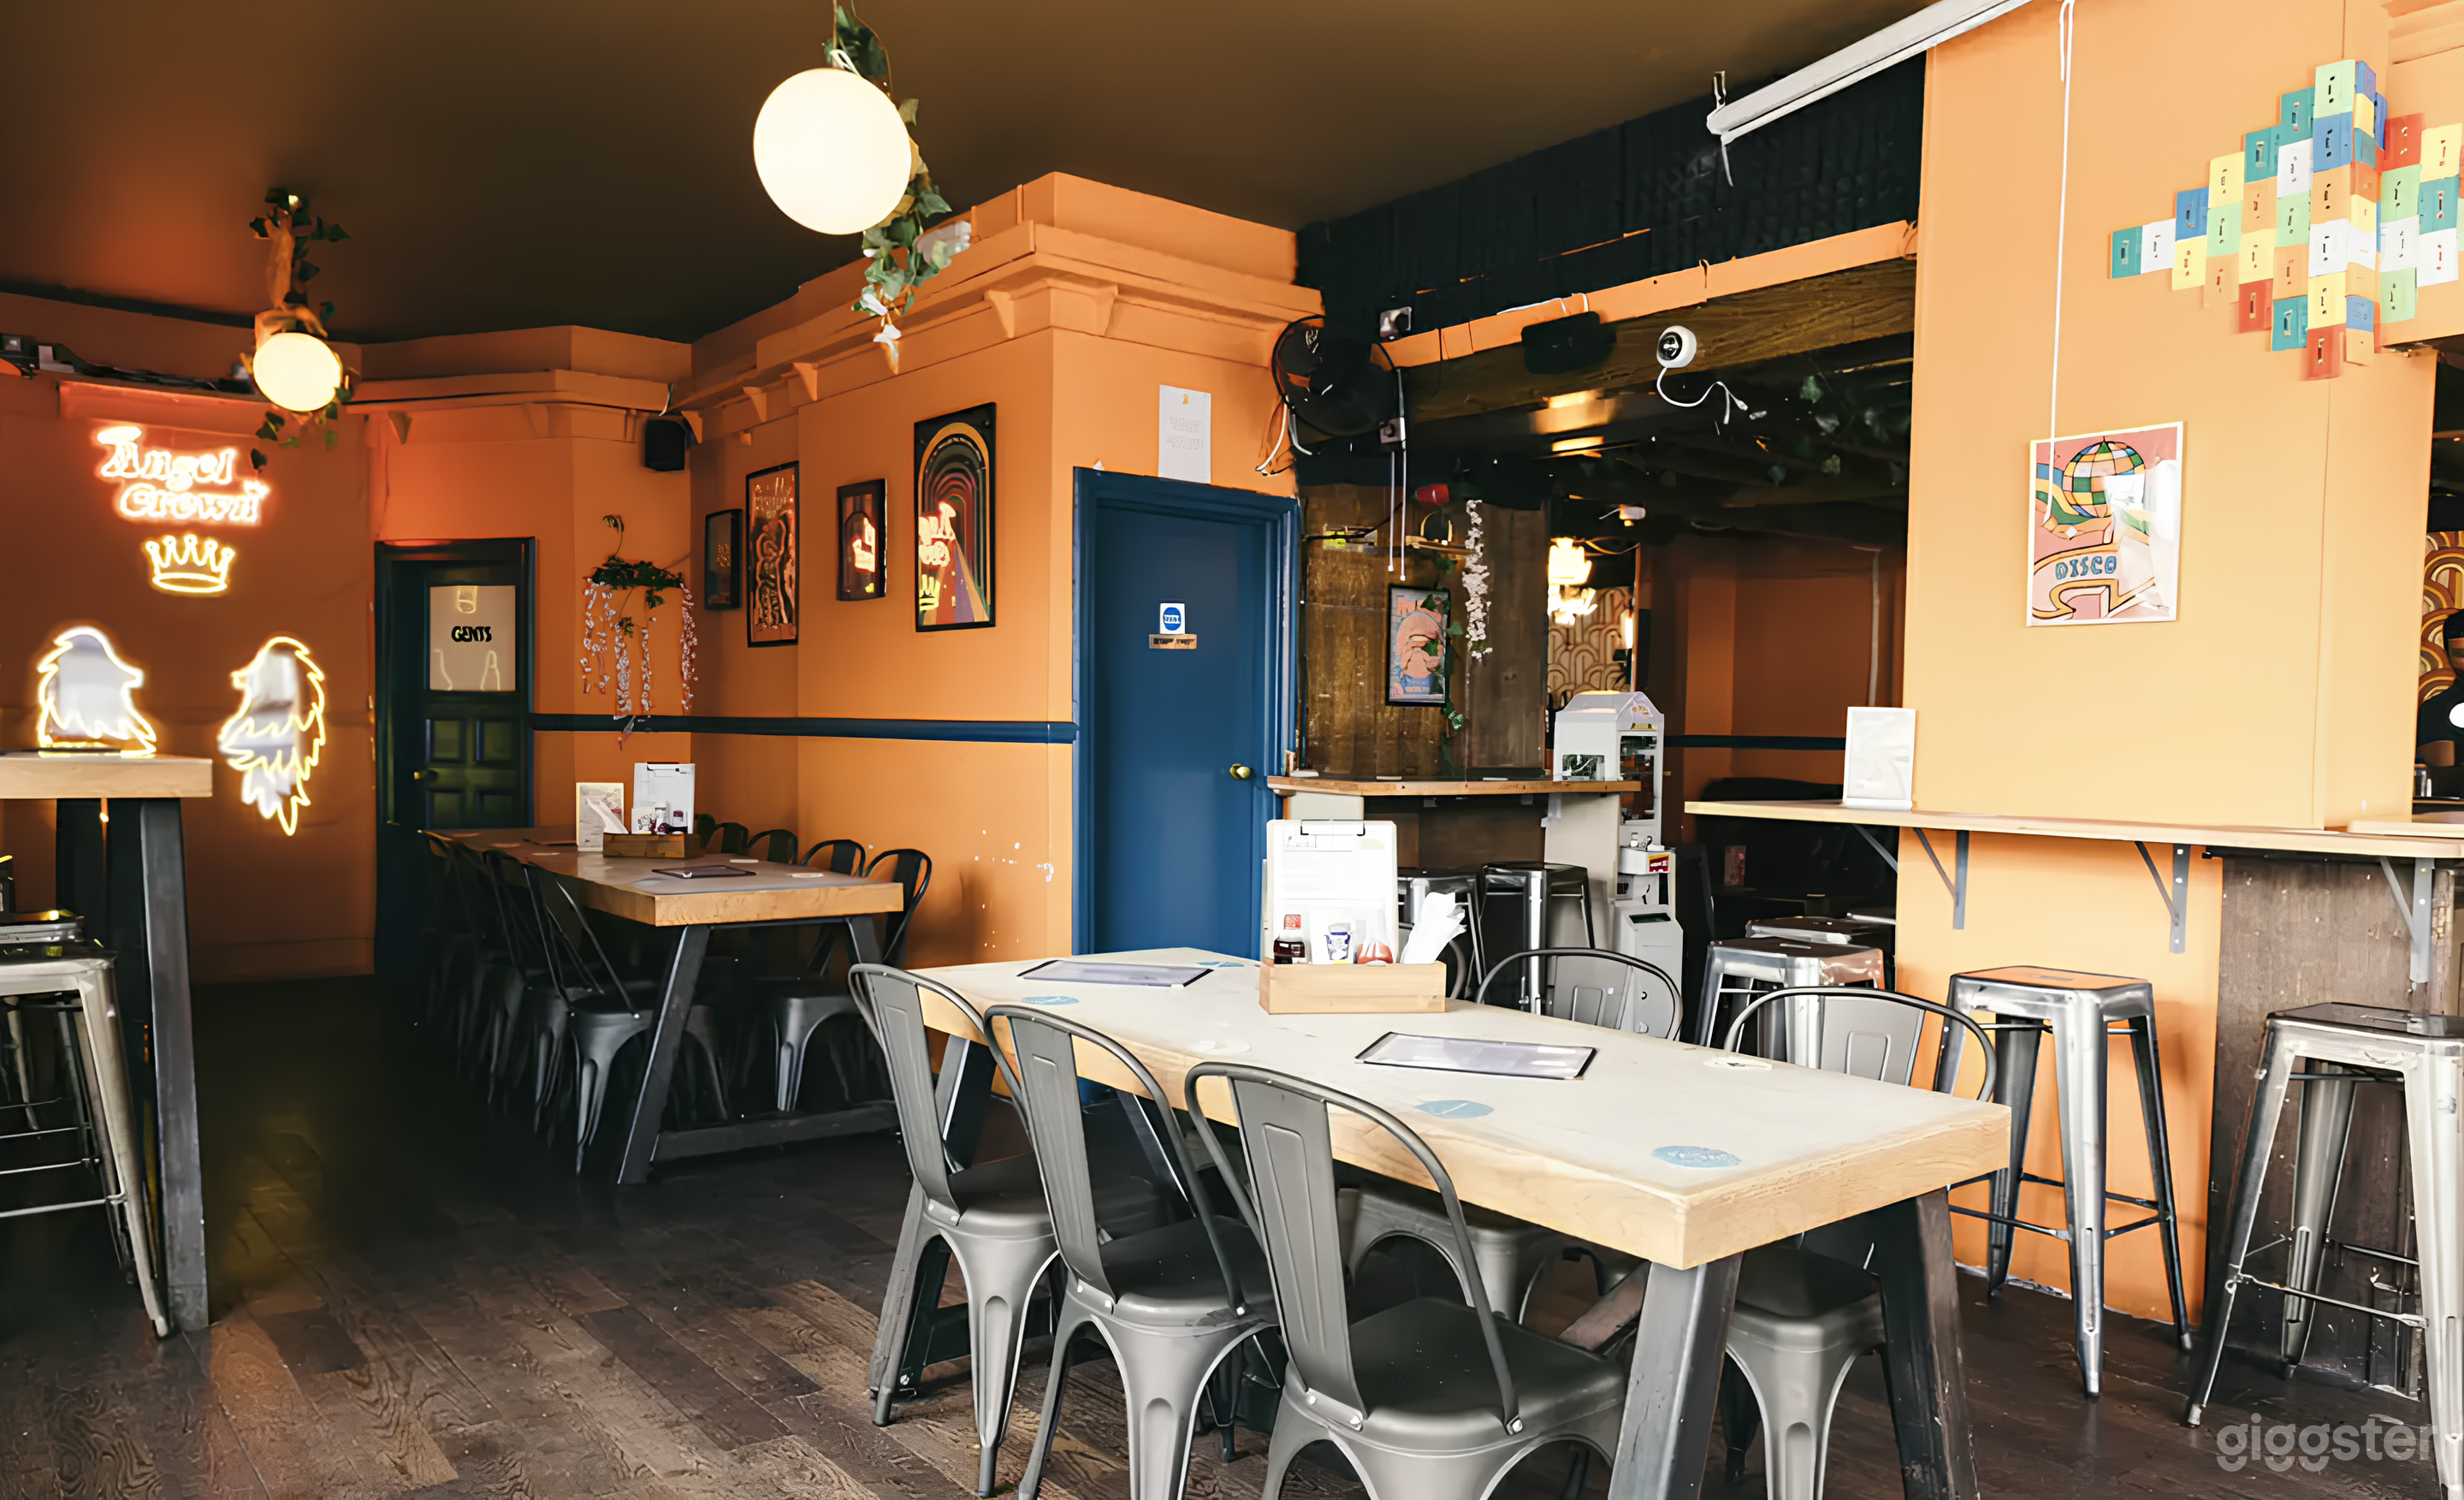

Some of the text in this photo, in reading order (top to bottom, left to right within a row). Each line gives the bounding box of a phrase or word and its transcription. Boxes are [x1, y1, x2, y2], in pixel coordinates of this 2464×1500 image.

[97, 426, 237, 490] Angel
[118, 481, 269, 524] Crown
[2055, 556, 2117, 580] DISCO
